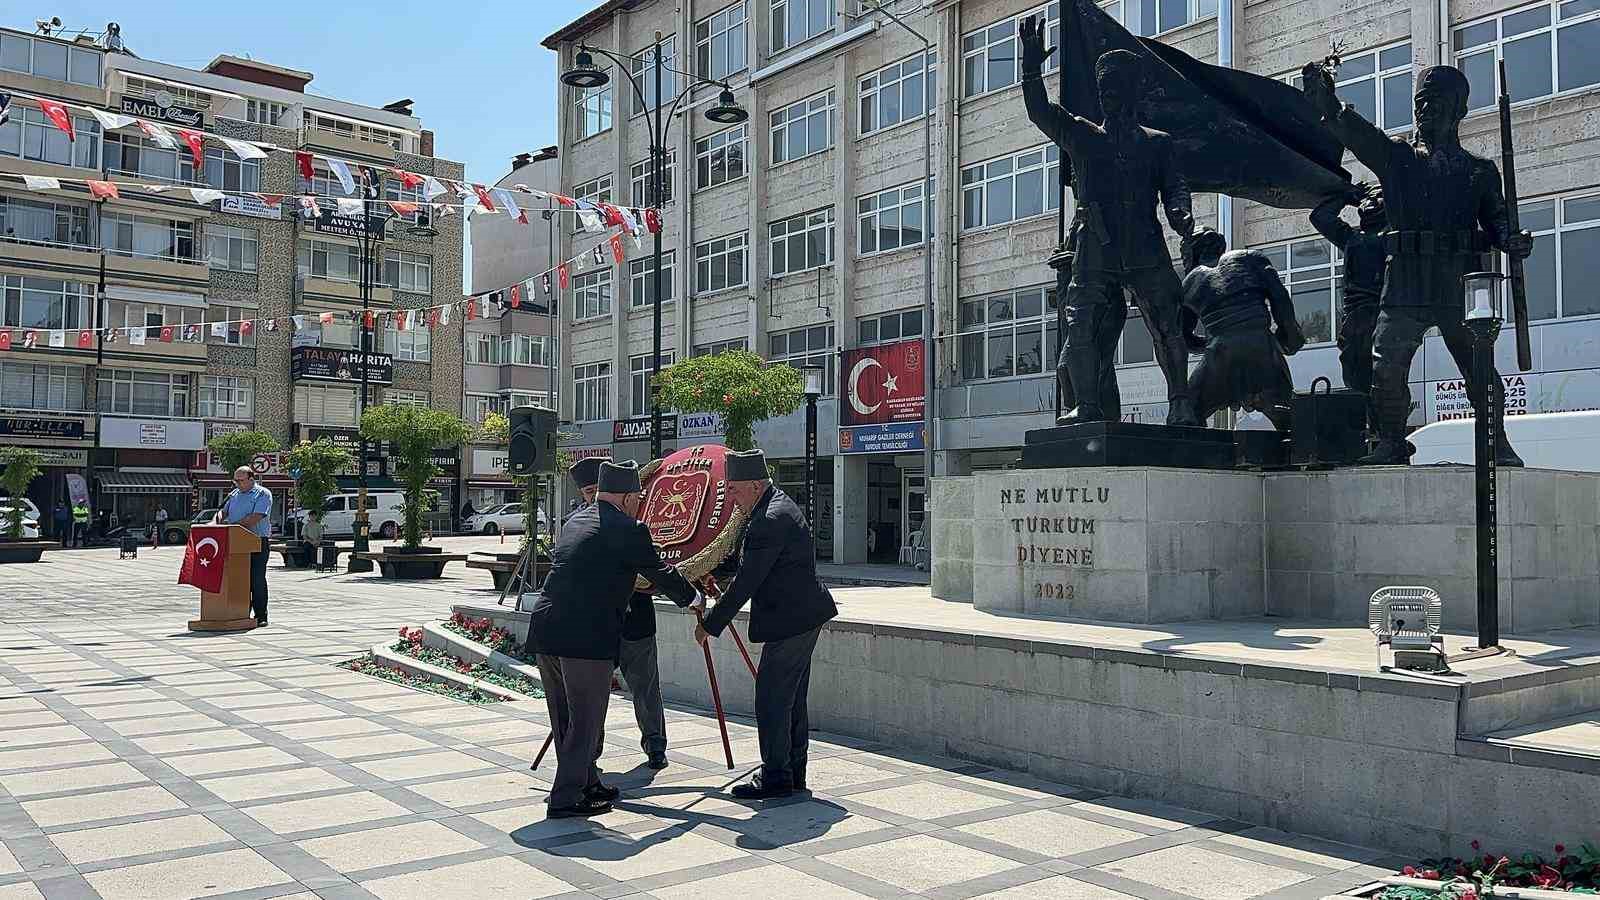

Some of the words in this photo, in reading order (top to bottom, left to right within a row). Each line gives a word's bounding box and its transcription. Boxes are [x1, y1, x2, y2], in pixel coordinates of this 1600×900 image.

[122, 100, 166, 119] EMEL
[331, 218, 371, 230] AVUKA
[1000, 488, 1026, 504] NE
[1036, 486, 1110, 503] MUTLU
